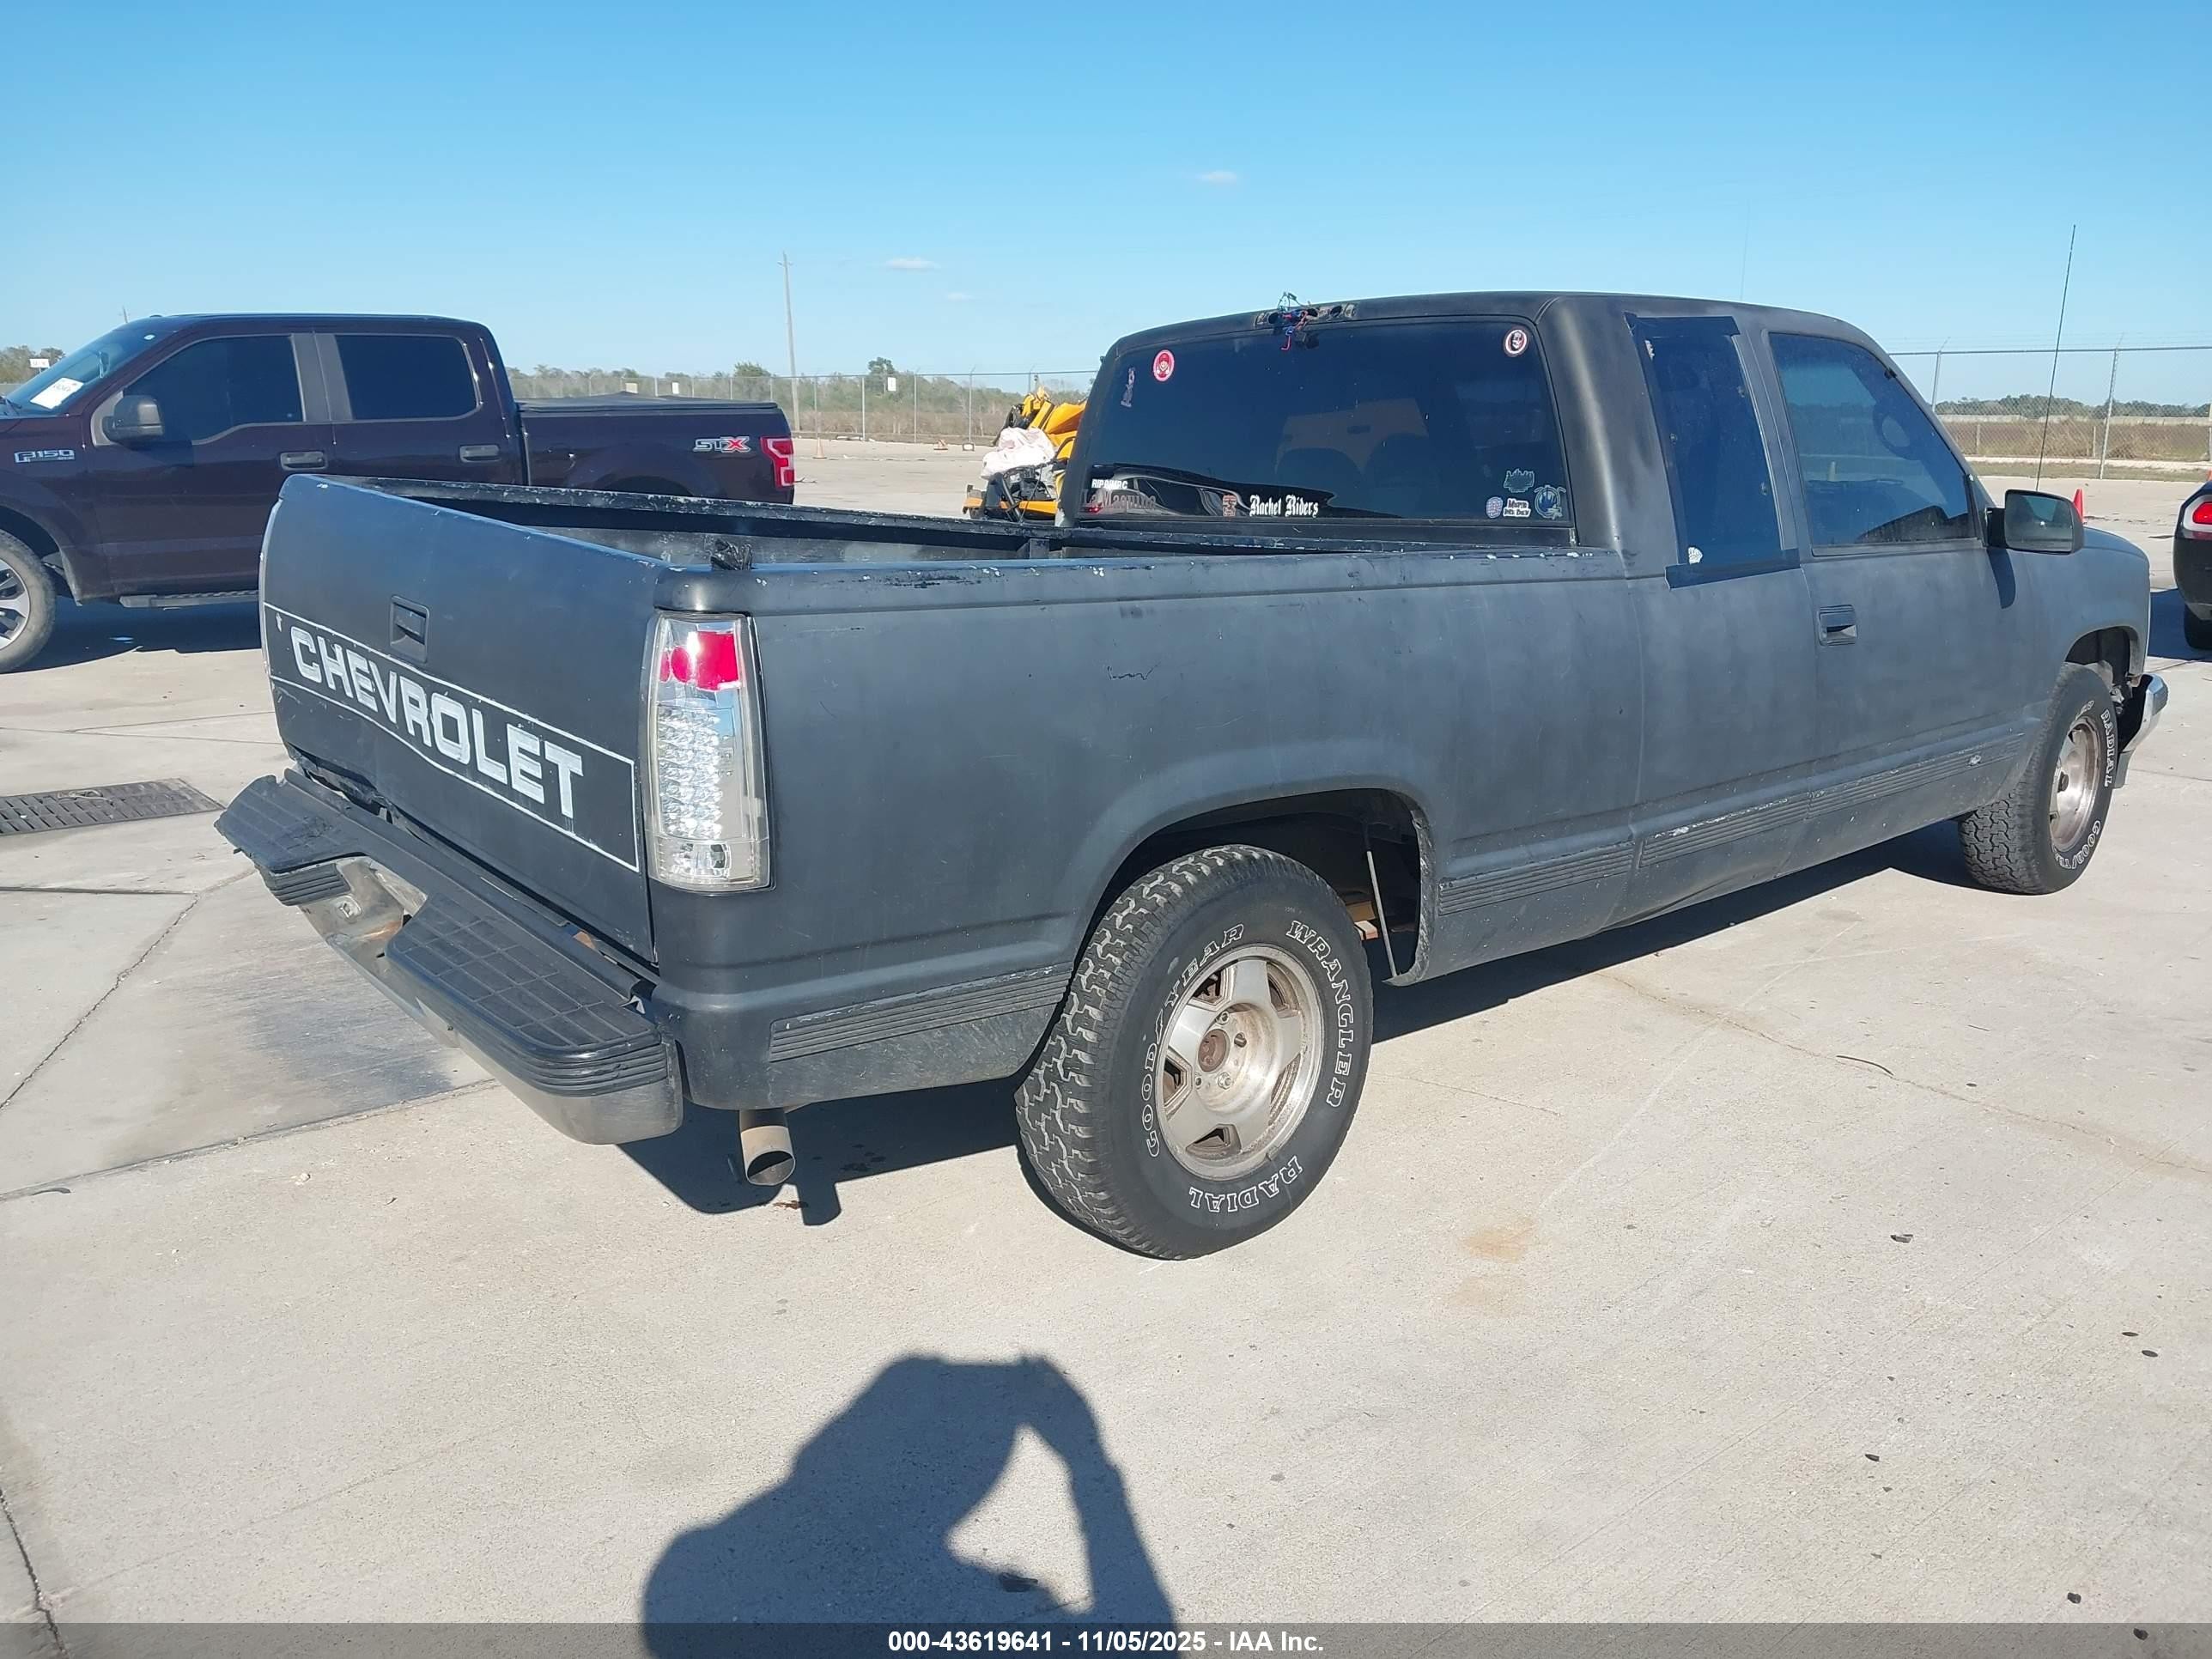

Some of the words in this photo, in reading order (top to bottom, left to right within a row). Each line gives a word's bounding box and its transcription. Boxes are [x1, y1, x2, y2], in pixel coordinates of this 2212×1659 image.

[693, 436, 751, 453] STX
[1285, 495, 1319, 518] Riders
[290, 626, 584, 819] CHEVROLET
[2100, 708, 2118, 788] RADIAL
[1142, 923, 1244, 1158] GOODYEAR
[1286, 921, 1355, 1108] WRANGLER
[1189, 1156, 1303, 1212] RADIAL
